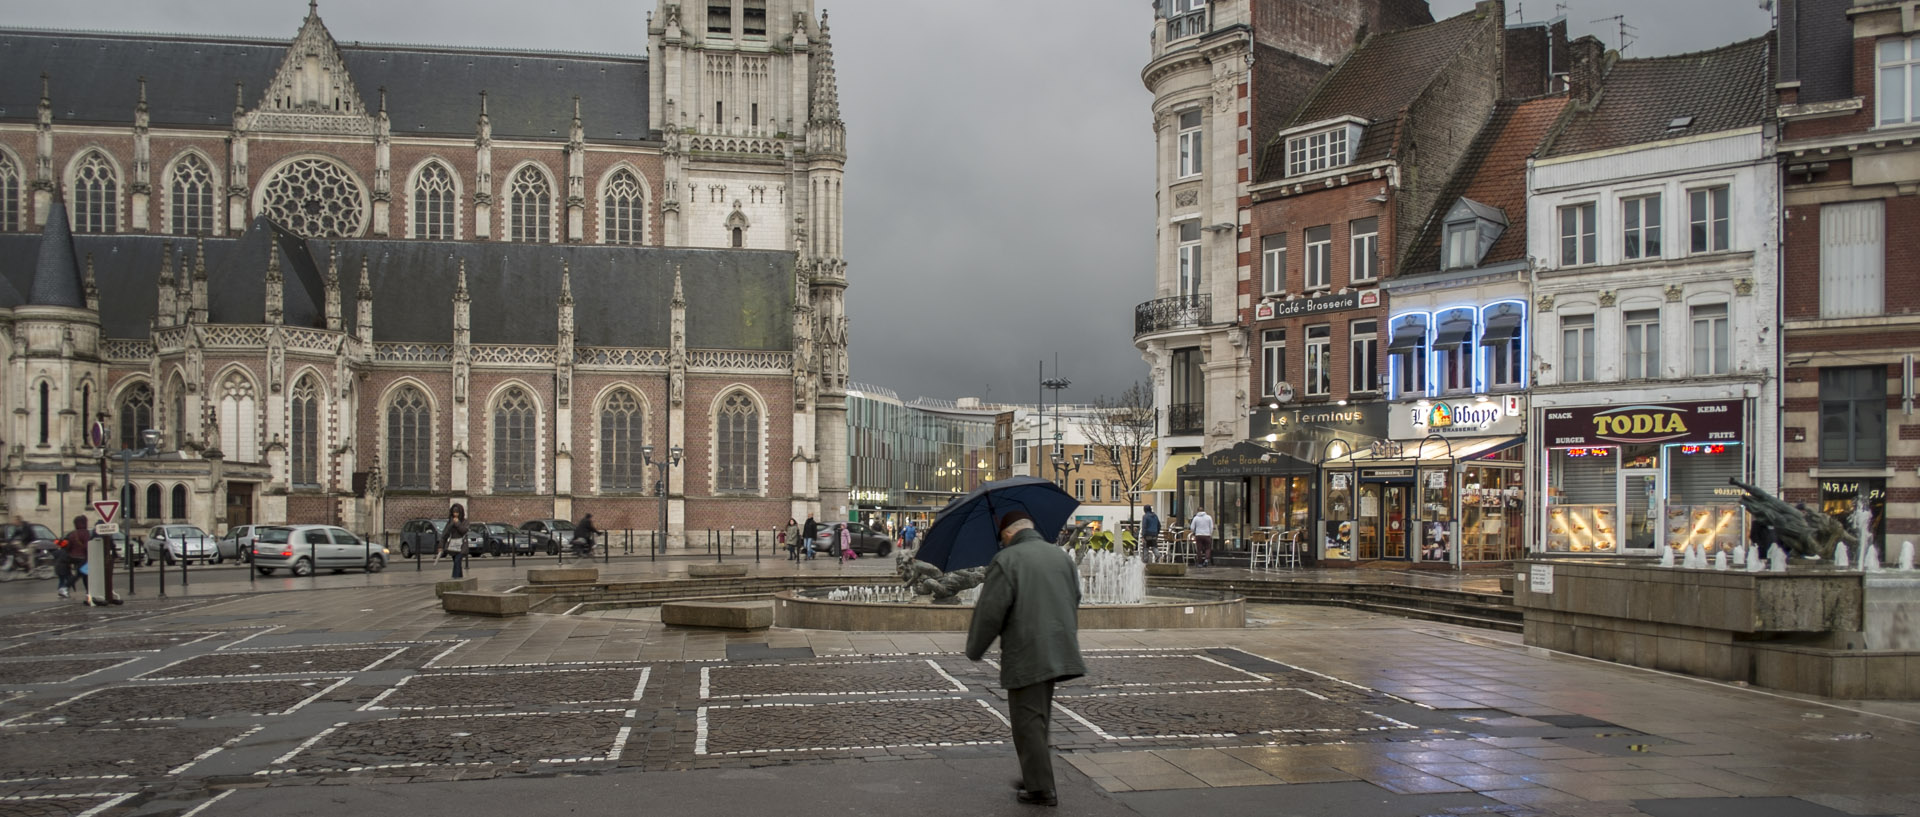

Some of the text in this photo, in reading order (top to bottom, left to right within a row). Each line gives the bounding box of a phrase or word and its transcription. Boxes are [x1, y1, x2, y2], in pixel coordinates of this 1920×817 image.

[1279, 302, 1299, 314] Café
[1307, 299, 1353, 311] Brasserie
[1697, 405, 1728, 413] KEBAB
[1270, 409, 1363, 425] Le Terminus
[1548, 412, 1573, 420] SNACK
[1593, 412, 1688, 435] TODIA
[1708, 431, 1735, 439] FRITE
[1370, 438, 1401, 458] Leffe
[1212, 455, 1229, 465] Café
